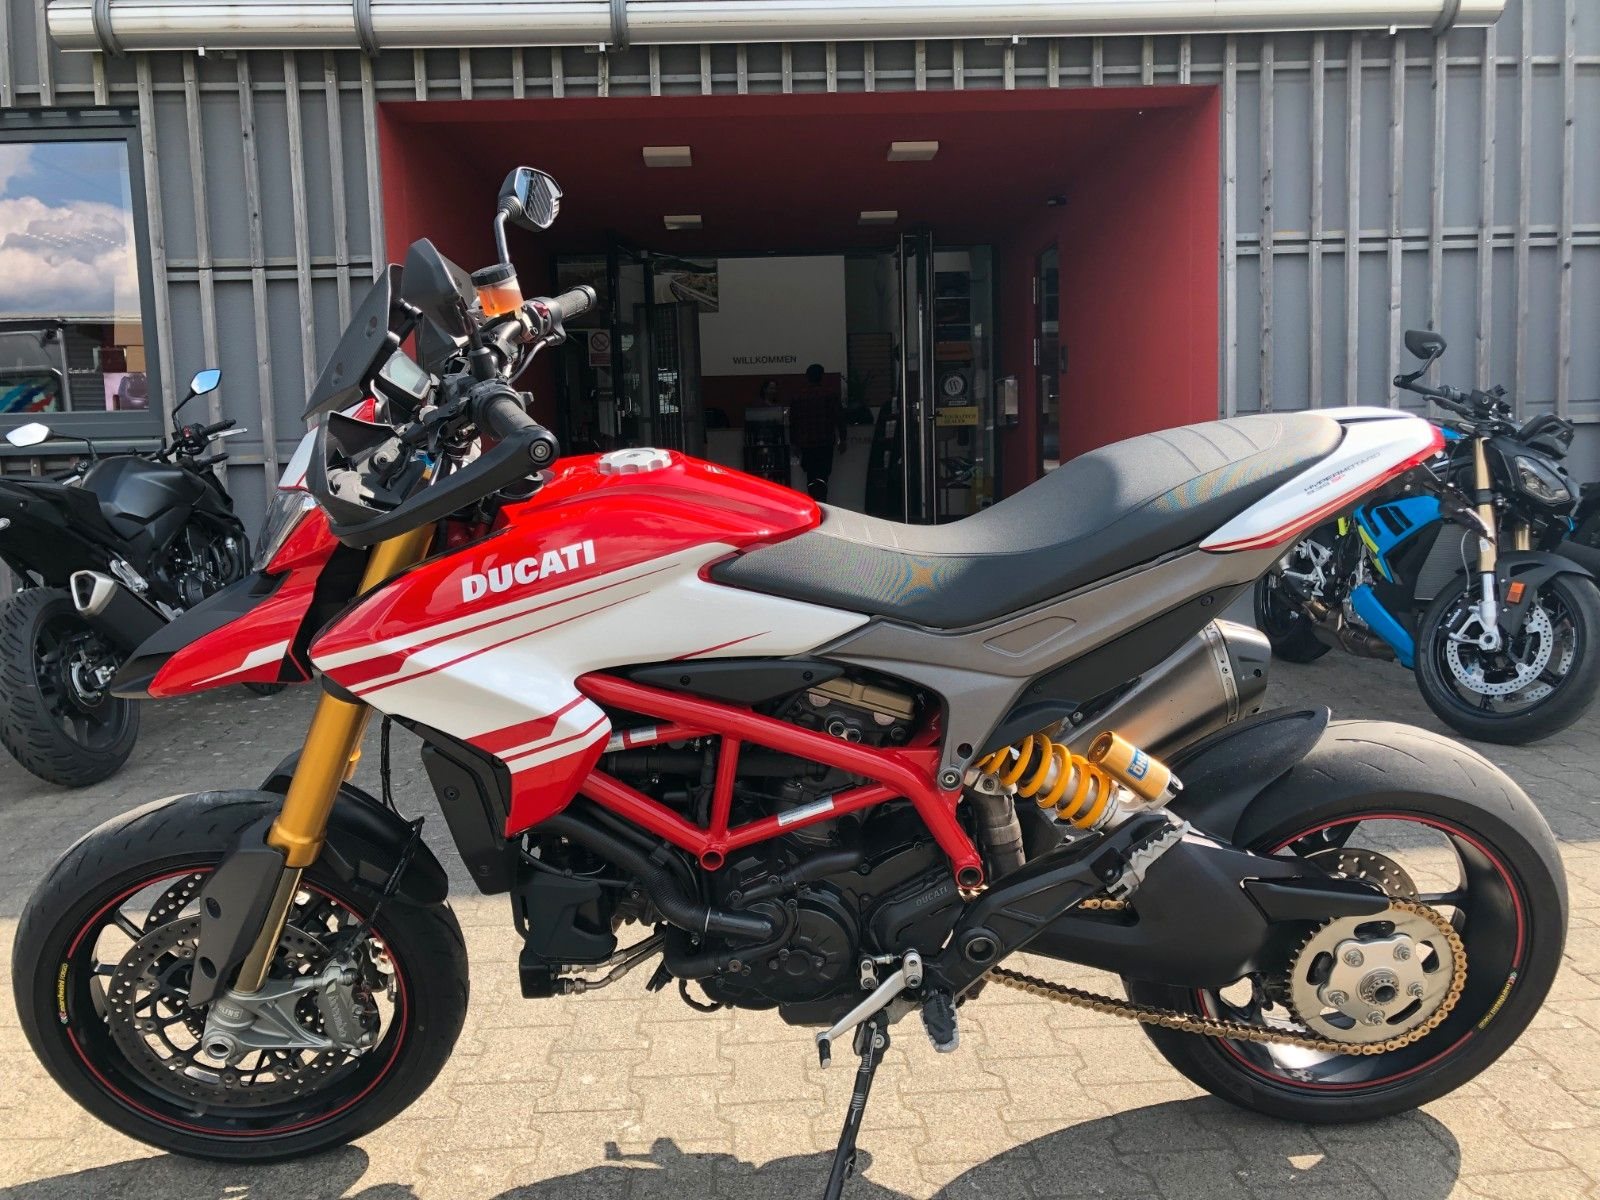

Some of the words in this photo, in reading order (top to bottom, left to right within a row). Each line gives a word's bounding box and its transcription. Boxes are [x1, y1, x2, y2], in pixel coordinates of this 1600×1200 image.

[732, 355, 797, 364] WILLKOMMEN
[1303, 450, 1381, 492] HYPERMOTARD
[461, 539, 596, 603] DUCATI
[915, 885, 949, 907] DUCATI
